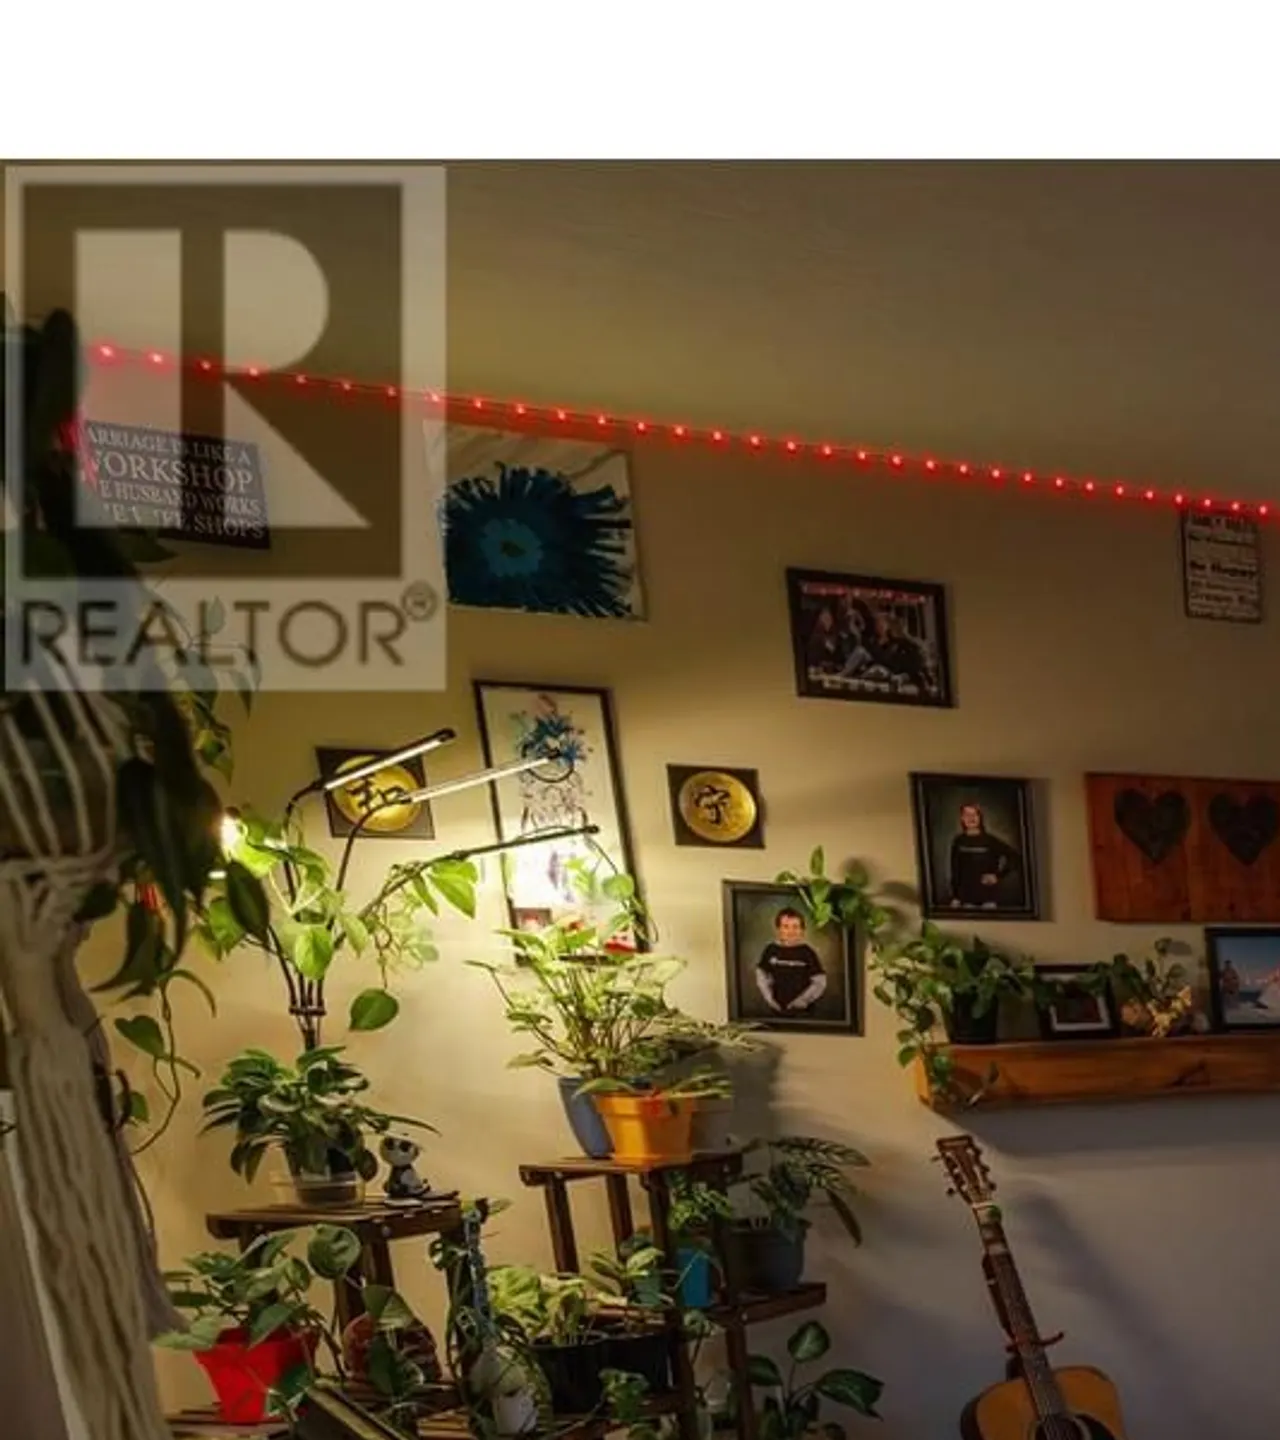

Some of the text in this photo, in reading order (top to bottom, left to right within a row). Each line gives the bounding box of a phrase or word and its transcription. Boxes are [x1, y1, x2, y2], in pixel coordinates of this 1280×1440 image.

[86, 427, 168, 453] ARRIAGE
[200, 491, 262, 517] WORKS
[194, 515, 264, 539] SHOPS
